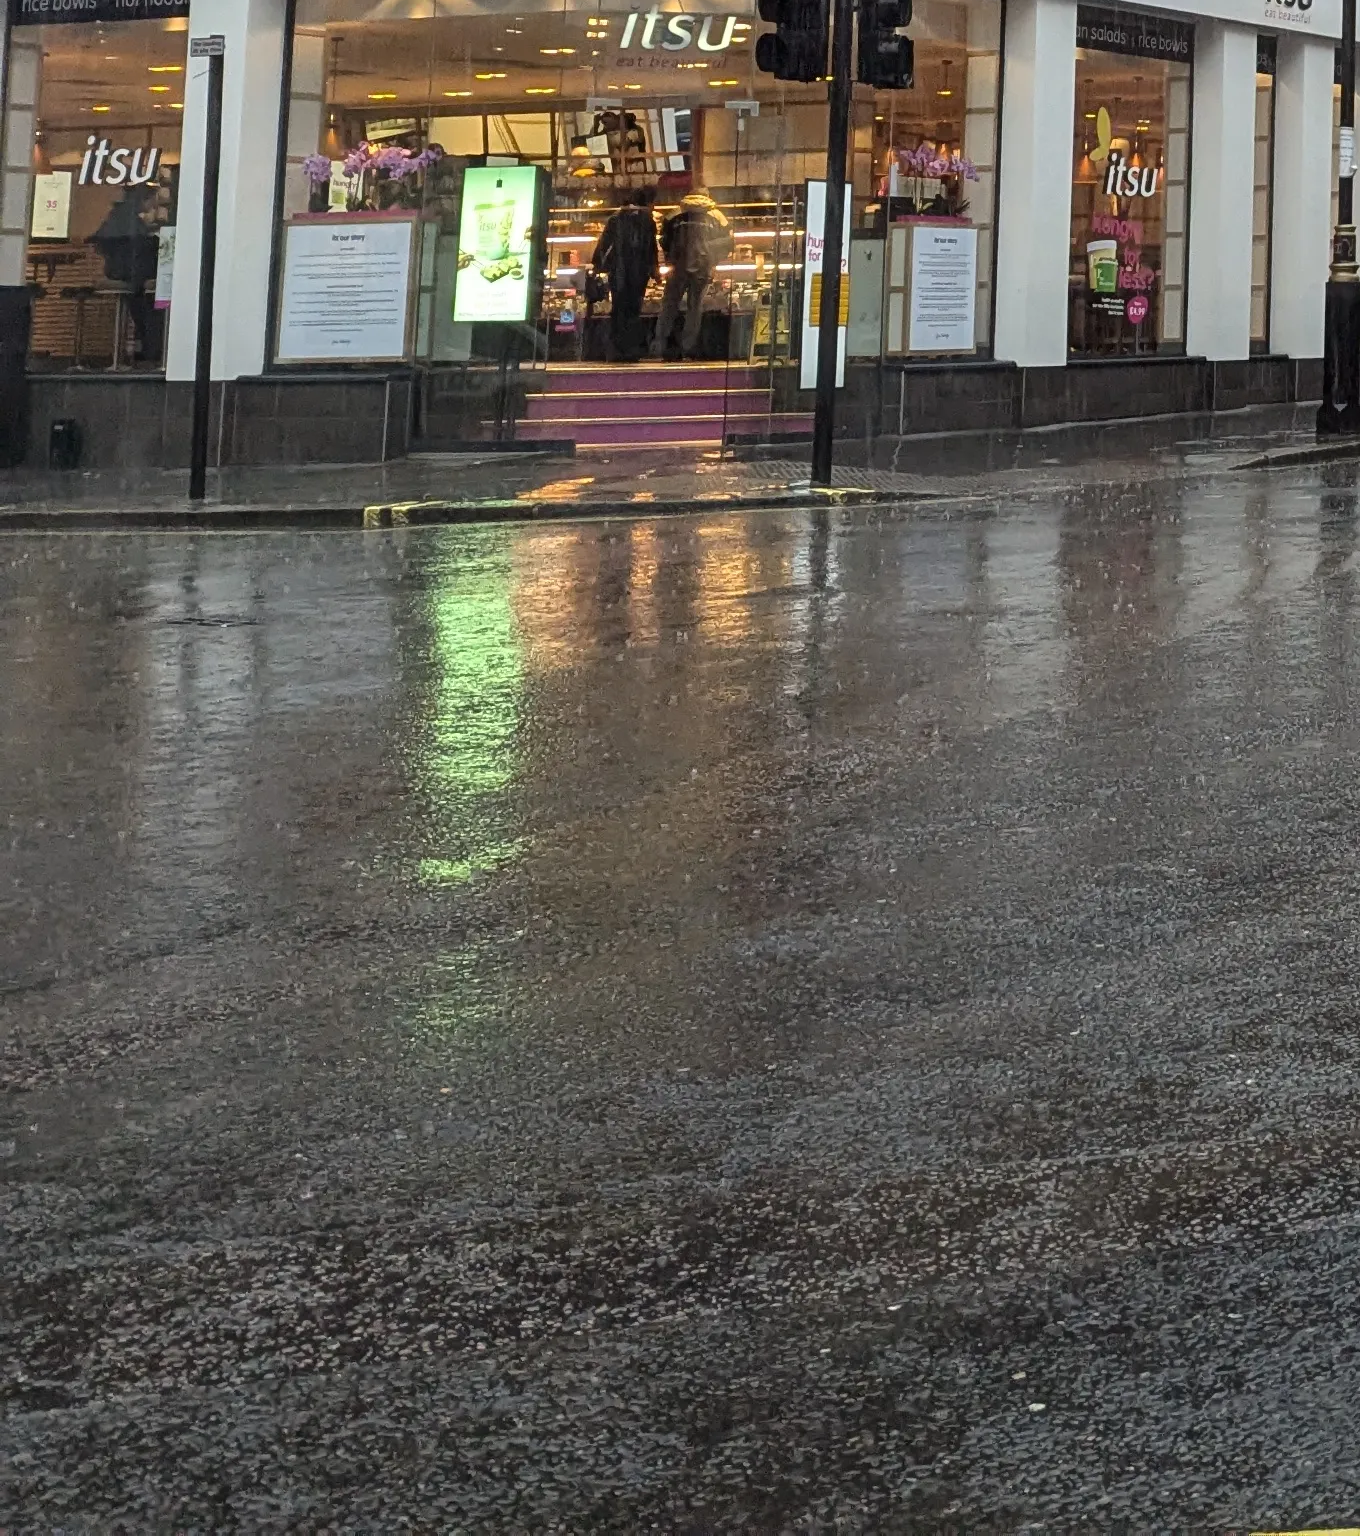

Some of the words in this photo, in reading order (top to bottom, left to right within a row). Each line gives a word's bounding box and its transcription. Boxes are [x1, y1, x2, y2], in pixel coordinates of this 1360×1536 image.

[619, 3, 738, 52] itsu
[1090, 24, 1127, 44] salads
[1138, 33, 1157, 49] rice
[1158, 33, 1188, 53] bowls
[78, 135, 158, 185] itsu
[1106, 152, 1158, 197] itsu
[808, 249, 821, 261] for
